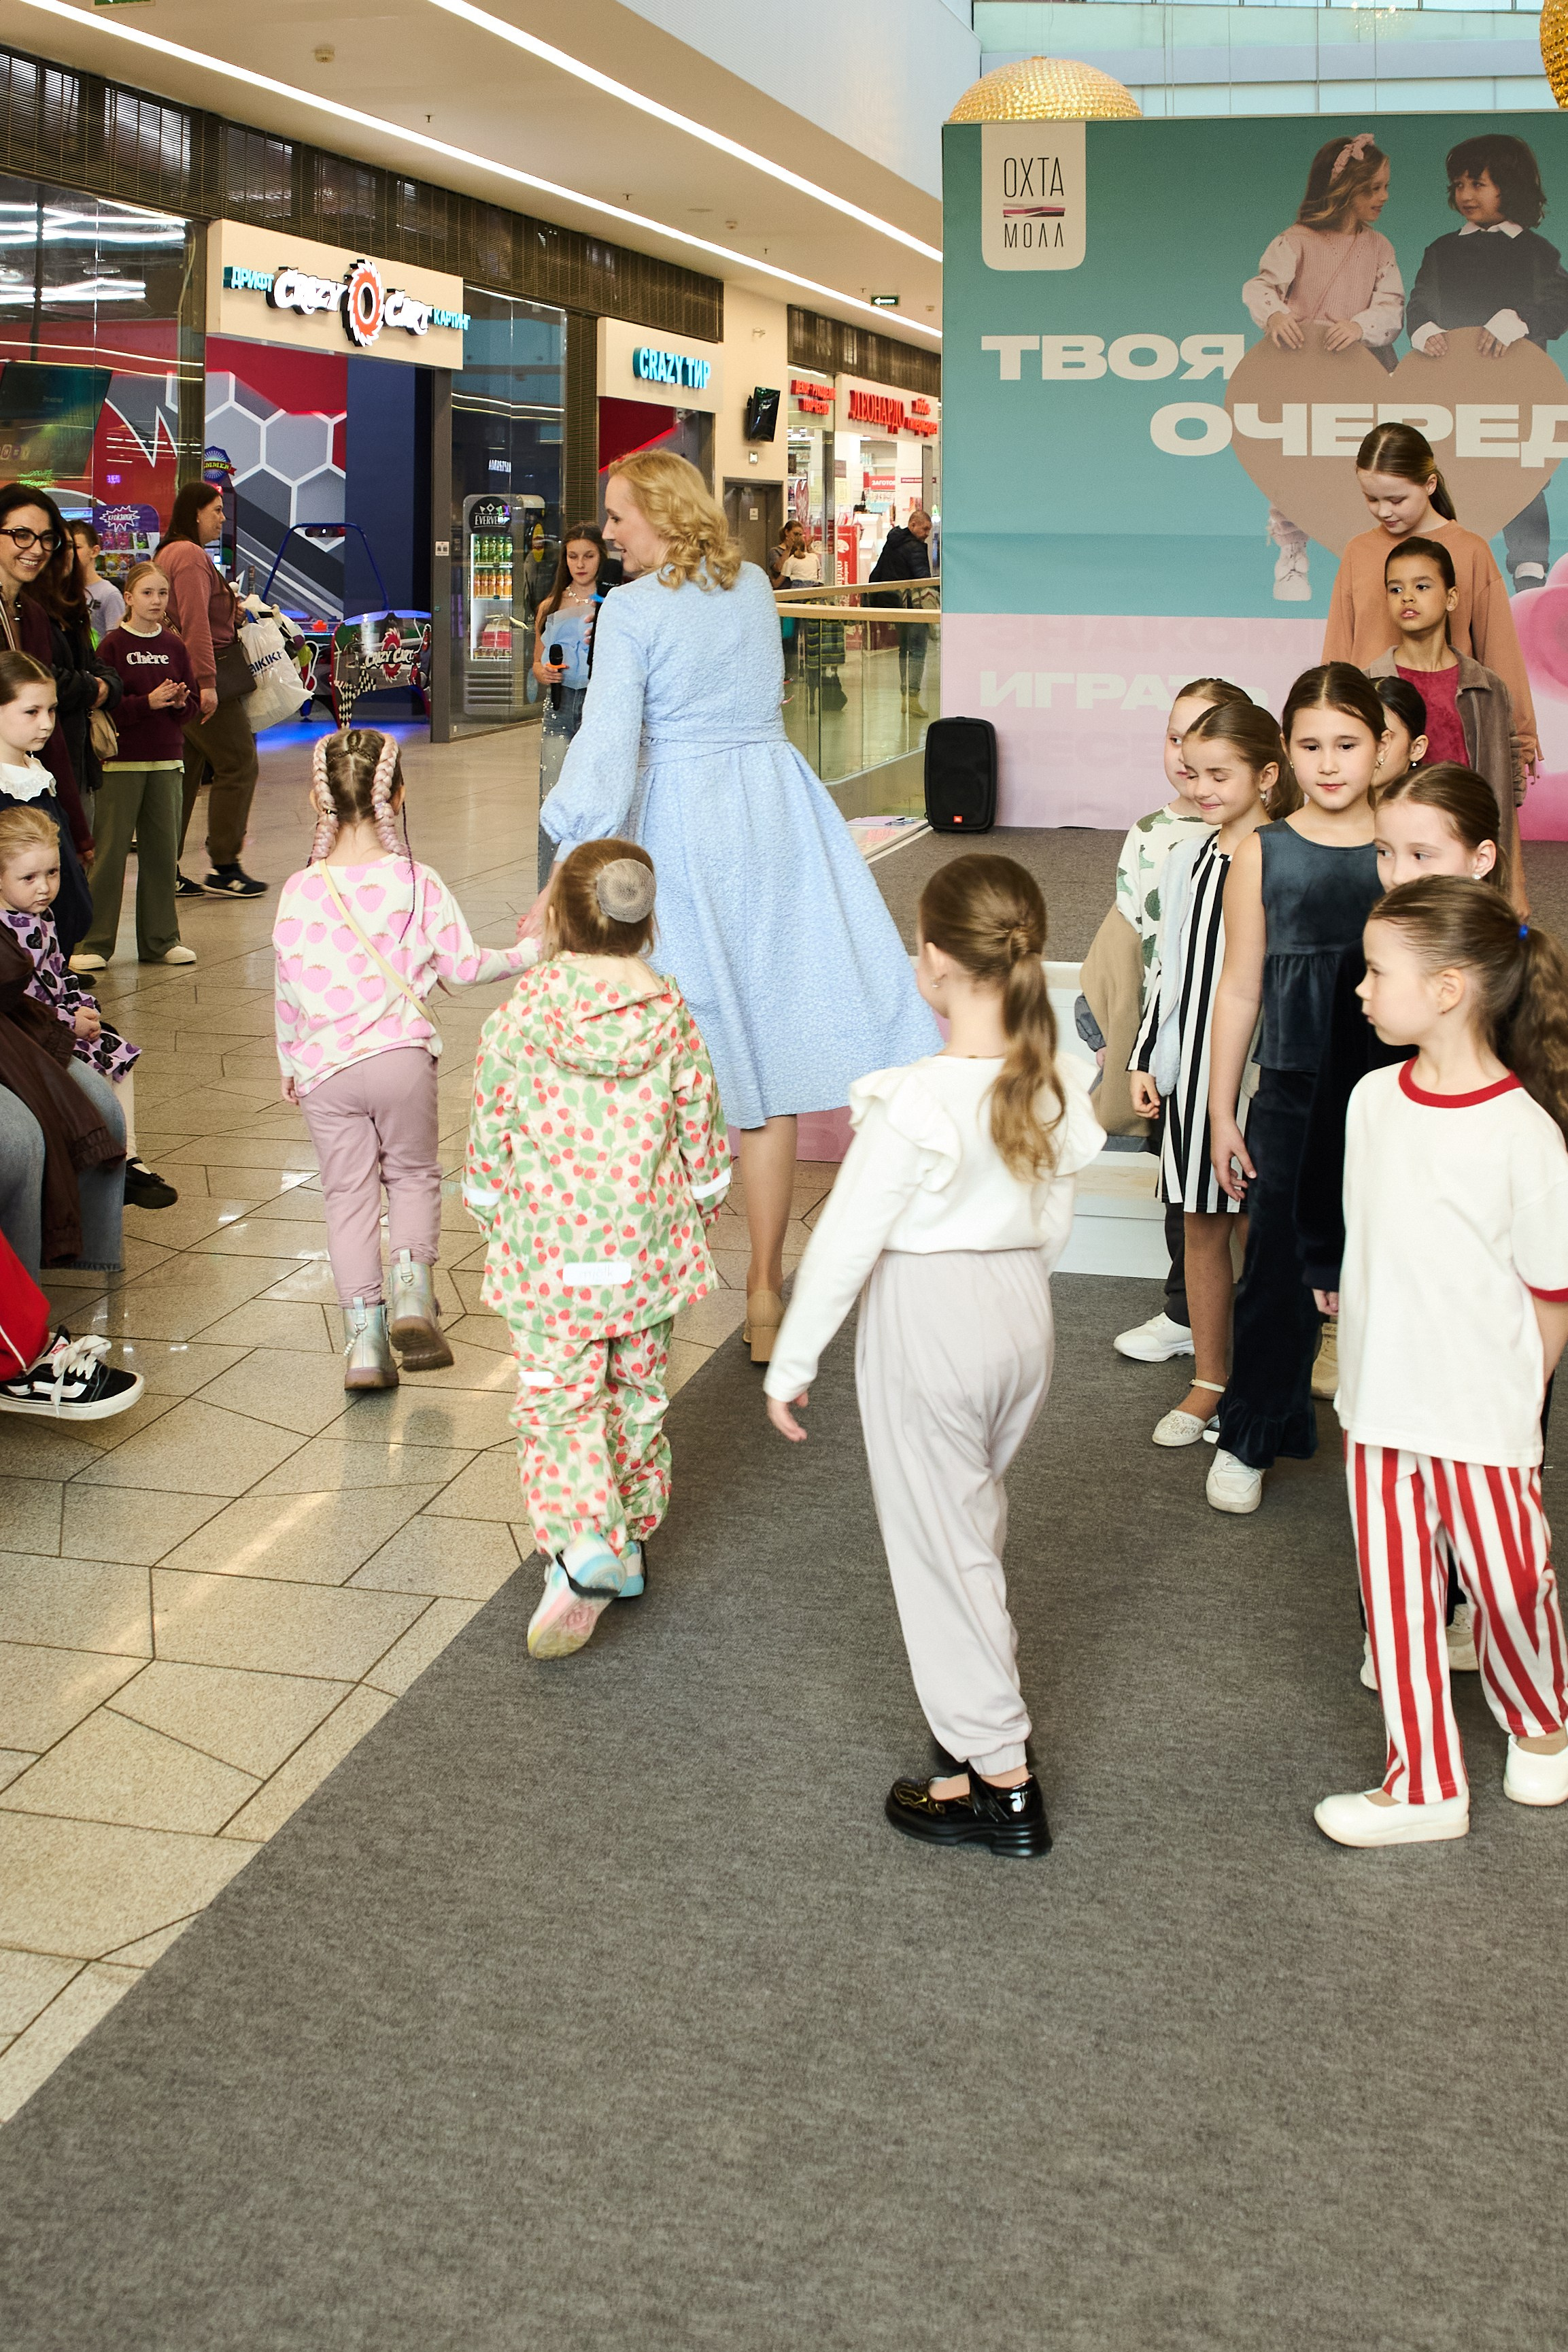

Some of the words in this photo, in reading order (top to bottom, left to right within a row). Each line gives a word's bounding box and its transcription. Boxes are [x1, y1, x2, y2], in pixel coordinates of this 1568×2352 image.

[1004, 157, 1064, 197] ОХТА
[1004, 222, 1064, 248] МОЛЛ
[231, 266, 275, 292] ДРИФТ
[273, 268, 347, 315] CRAZY
[384, 290, 434, 335] CART
[432, 308, 471, 331] КАРТИНГ
[639, 347, 685, 384] CRAZY
[685, 357, 711, 389] ТИР
[981, 333, 1244, 381] ТВОЯ
[851, 391, 905, 433] ЛЕОНАРДО
[126, 651, 169, 665] Chère
[365, 650, 392, 667] CRAZY
[392, 648, 414, 663] CART
